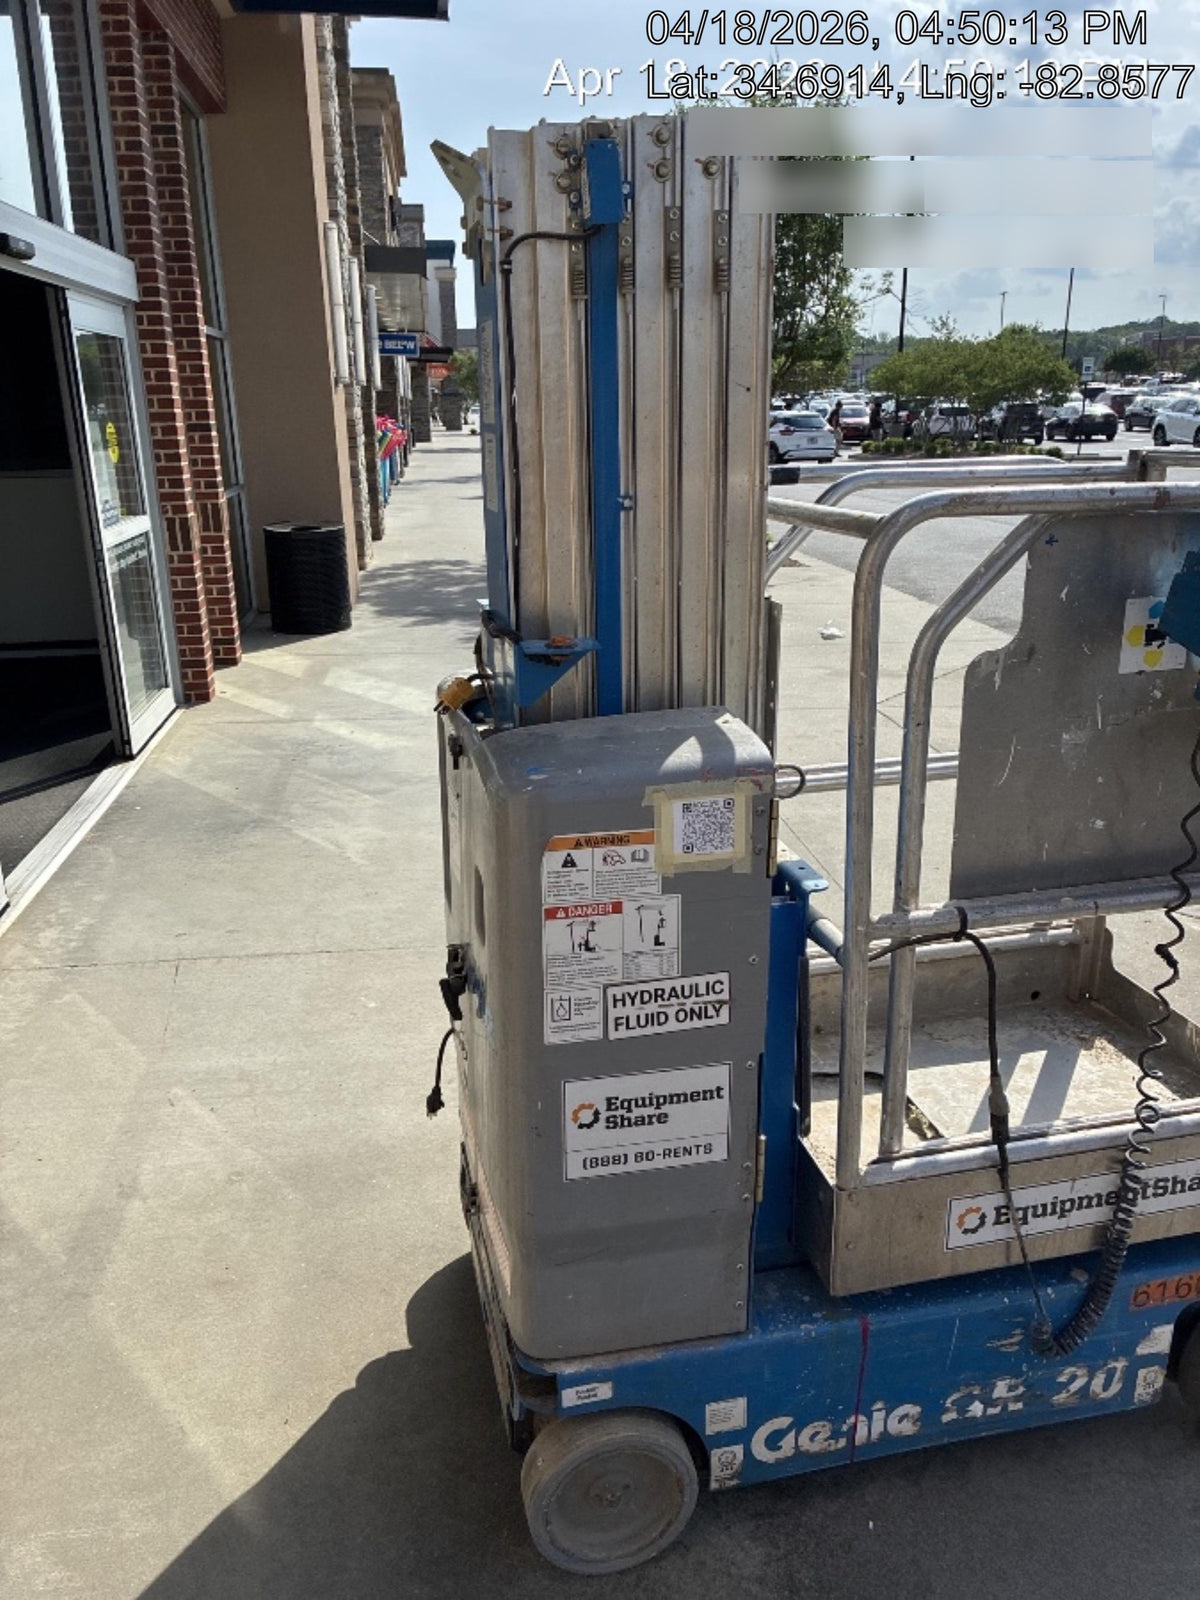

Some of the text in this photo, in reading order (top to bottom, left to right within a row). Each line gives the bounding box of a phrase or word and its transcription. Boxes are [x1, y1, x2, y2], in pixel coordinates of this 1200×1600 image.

[585, 835, 631, 848] WARNING
[568, 903, 613, 917] DANGER
[612, 979, 725, 1009] HYDRAULIC
[614, 1010, 669, 1032] FLUID
[675, 1003, 723, 1023] ONLY
[605, 1085, 725, 1113] Equipment
[605, 1111, 669, 1130] Share
[582, 1142, 713, 1170] (888) 80-RENTS
[1132, 1274, 1200, 1309] 616
[751, 1400, 922, 1464] Genie
[1050, 1355, 1129, 1409] 20
